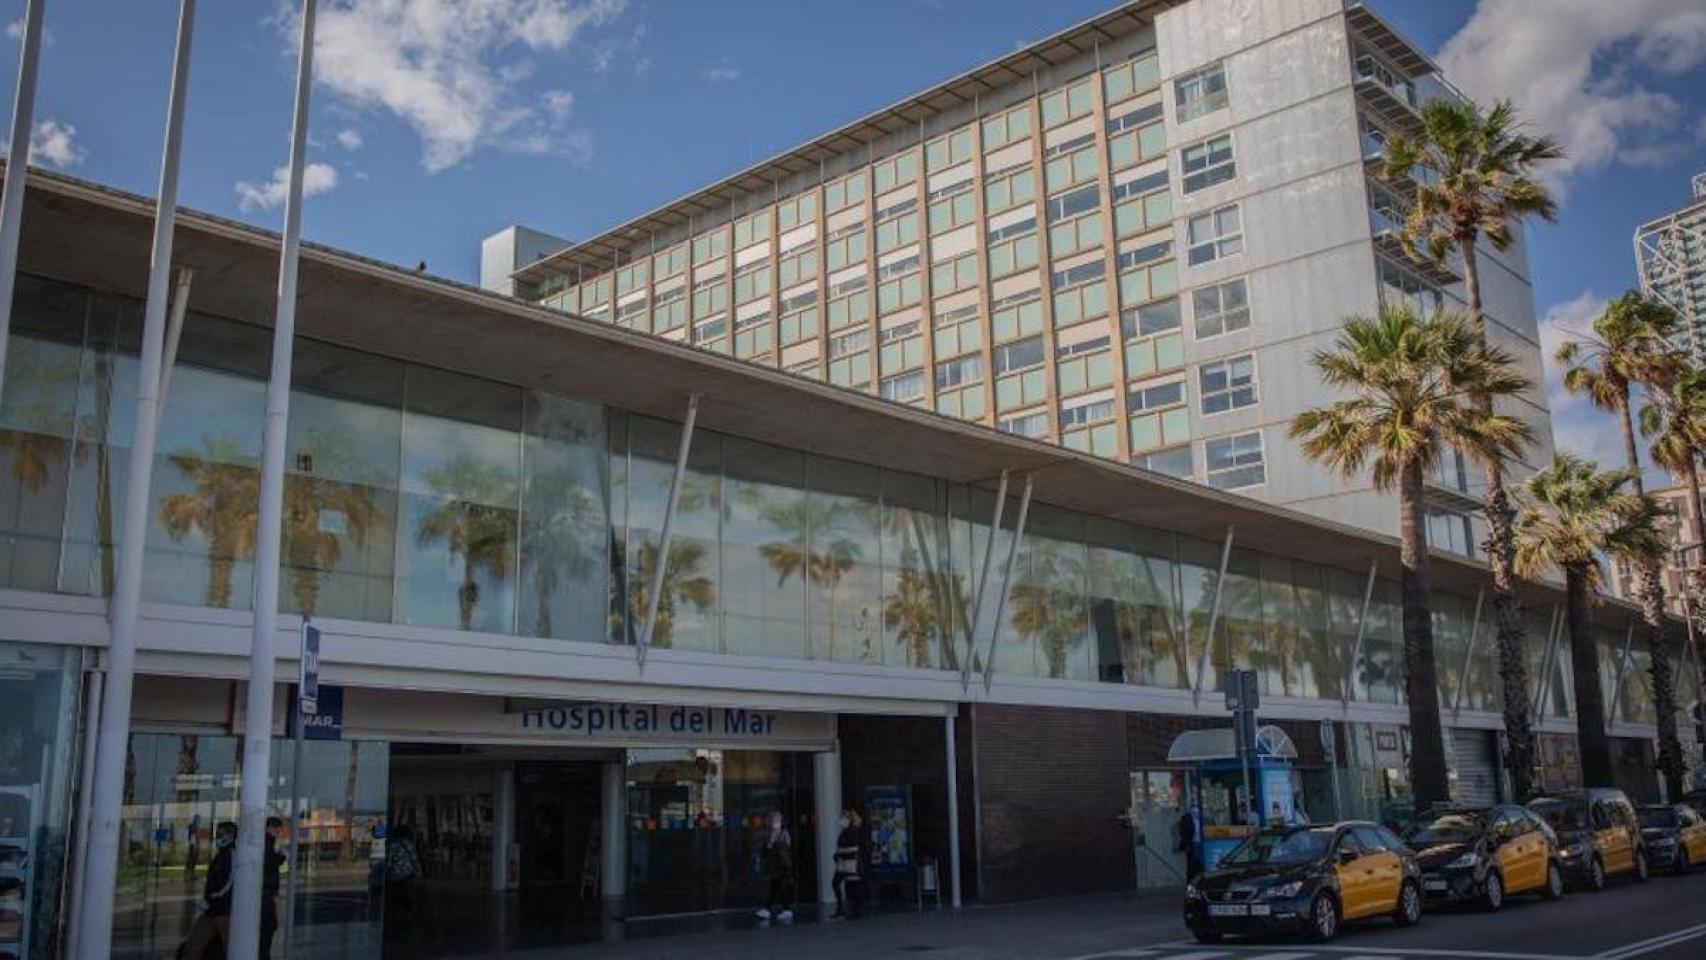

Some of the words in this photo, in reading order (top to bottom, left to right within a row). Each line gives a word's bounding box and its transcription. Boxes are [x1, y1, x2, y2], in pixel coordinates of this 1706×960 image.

[521, 703, 658, 736] Hospital
[669, 706, 712, 733] del
[724, 708, 776, 736] Mar
